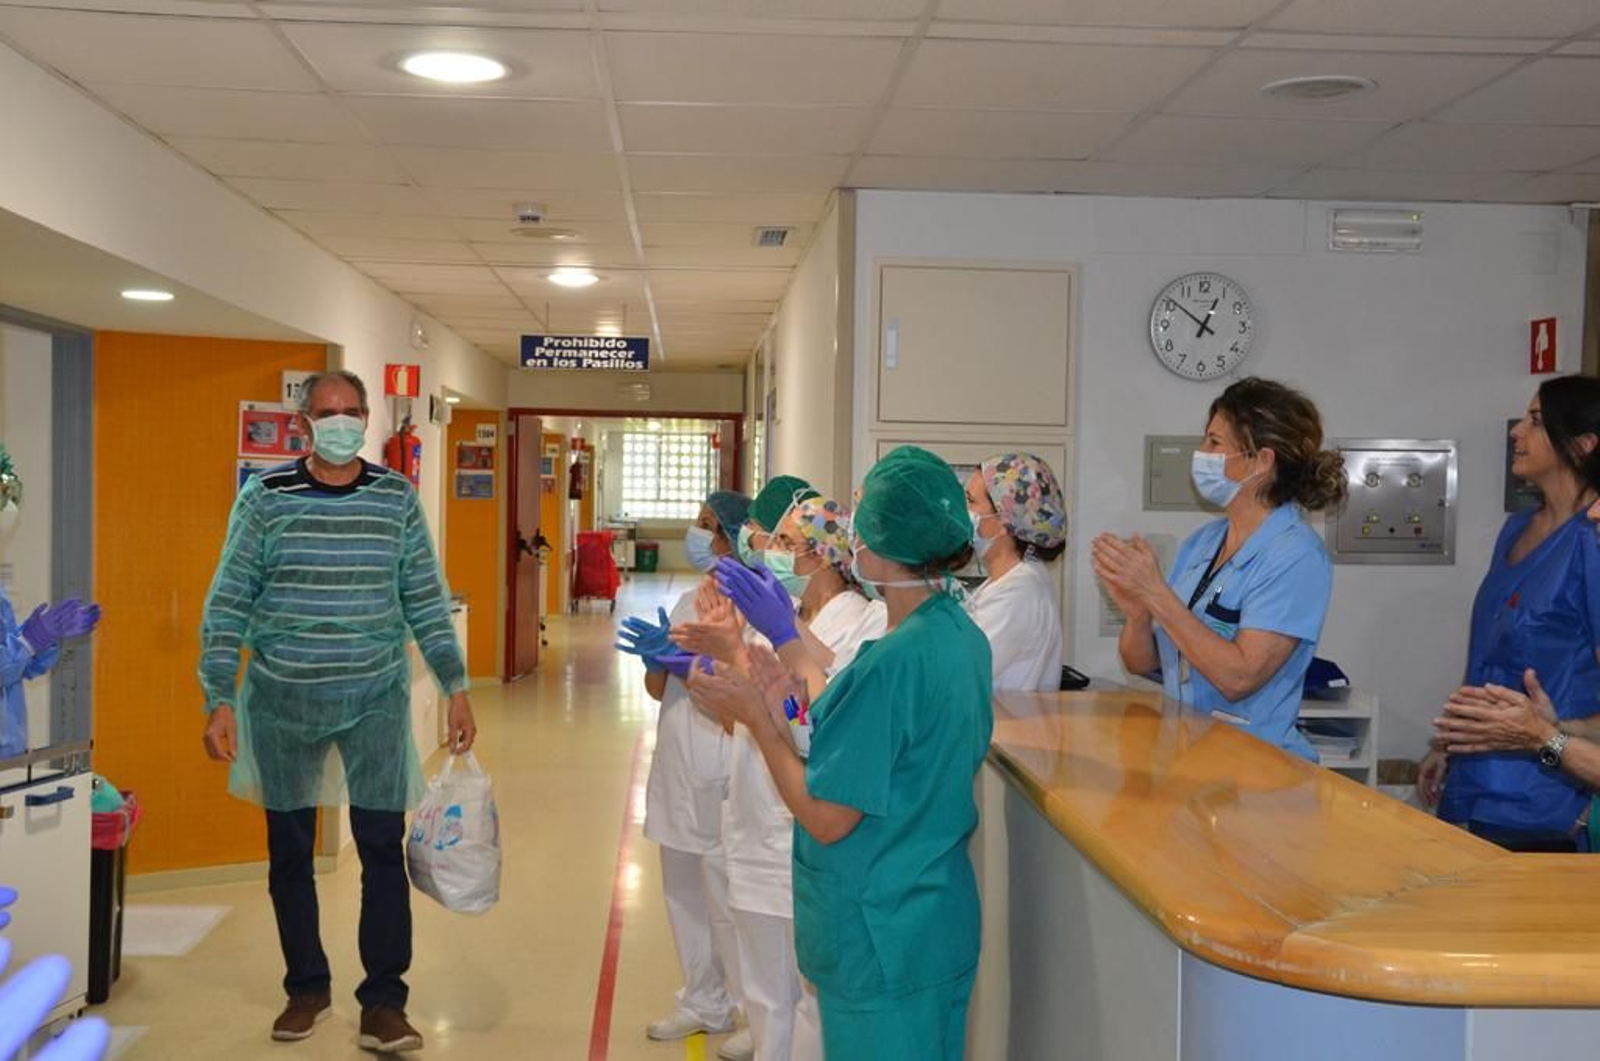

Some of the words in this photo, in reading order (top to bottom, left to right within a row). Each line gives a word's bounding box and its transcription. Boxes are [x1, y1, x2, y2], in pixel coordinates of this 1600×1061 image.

[1181, 285, 1191, 298] 11
[1199, 280, 1211, 293] 12
[1238, 321, 1247, 334] 3
[543, 337, 628, 349] Prohibido
[1165, 339, 1174, 352] 8
[1230, 341, 1239, 353] 4
[534, 347, 636, 359] Permanecer
[1178, 353, 1187, 363] 7
[526, 358, 548, 368] en
[553, 358, 577, 368] los
[581, 358, 645, 370] Pasillos
[1196, 361, 1206, 373] 6
[1216, 355, 1226, 368] 5
